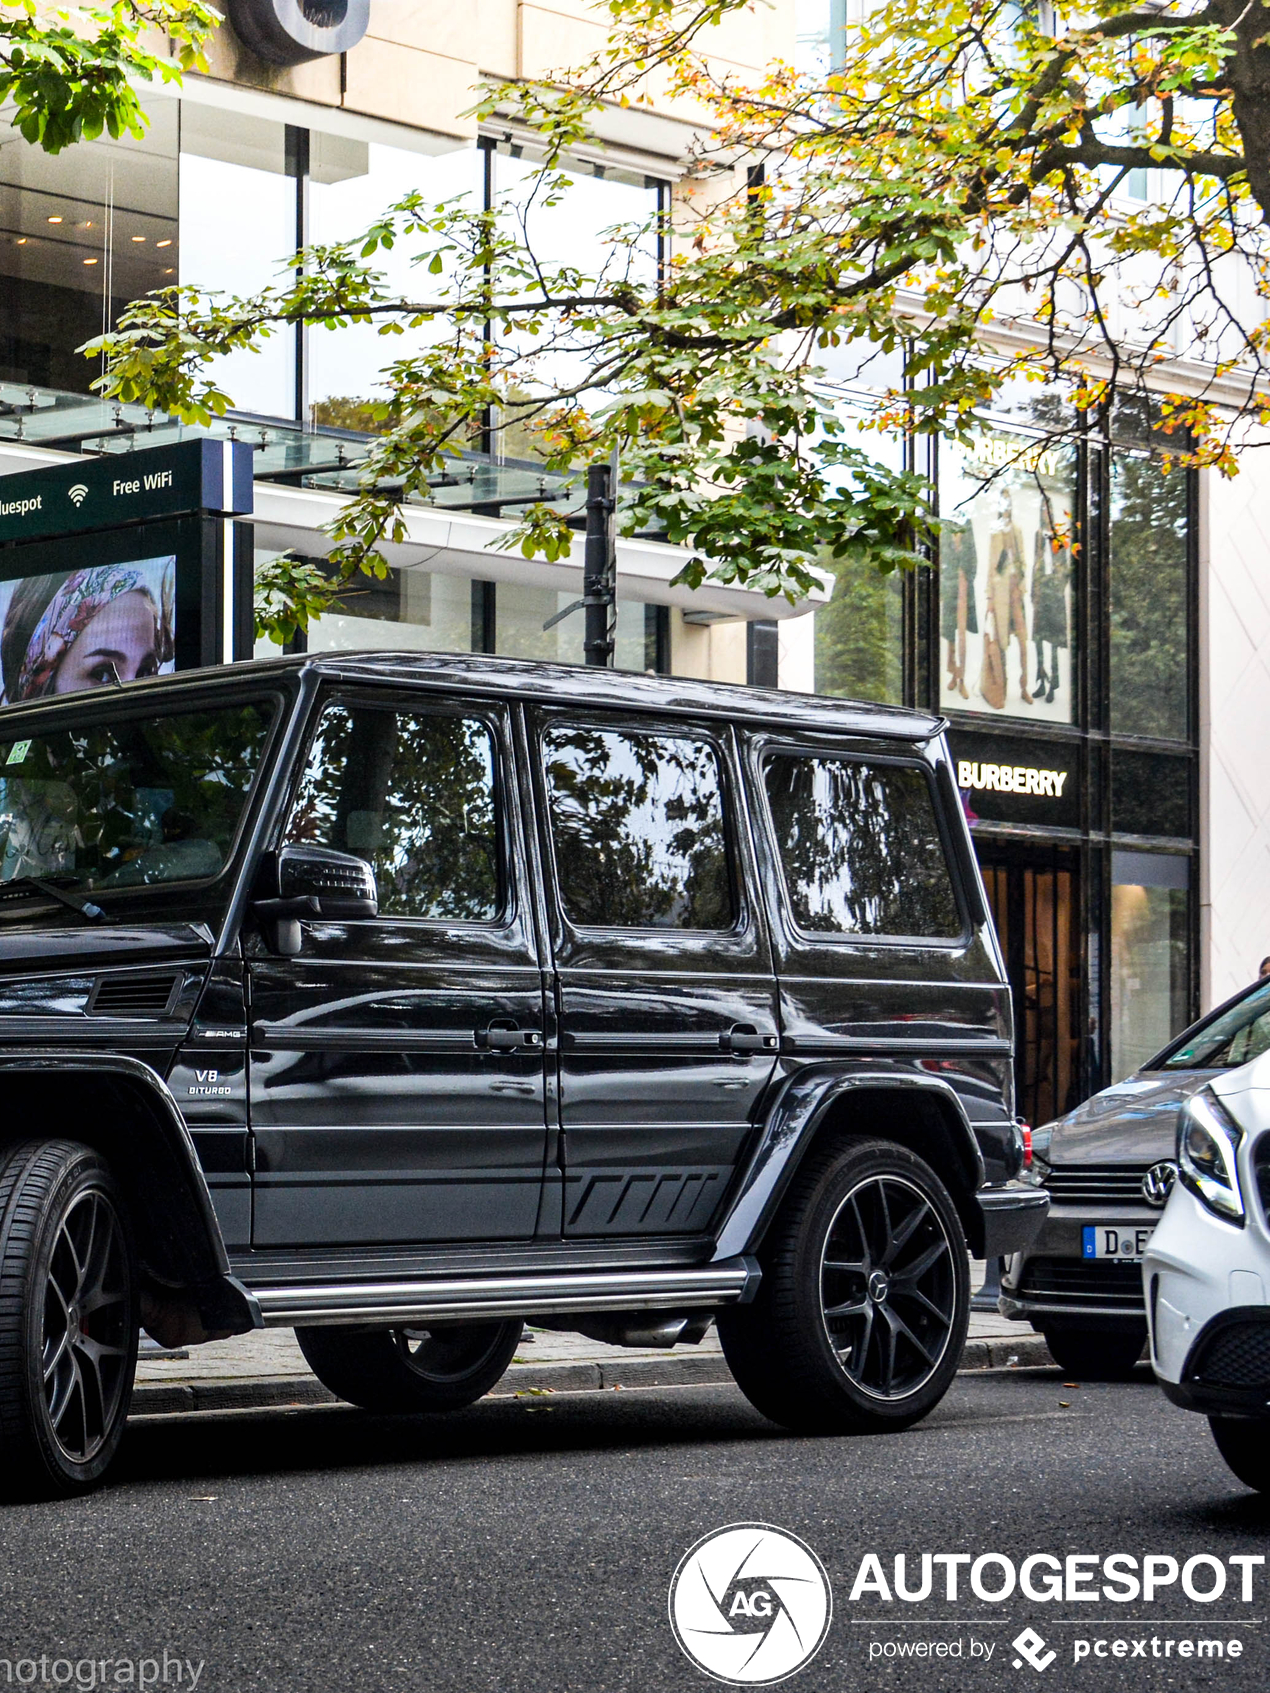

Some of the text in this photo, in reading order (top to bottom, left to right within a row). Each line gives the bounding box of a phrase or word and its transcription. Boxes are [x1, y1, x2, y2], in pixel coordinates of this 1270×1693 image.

[113, 480, 140, 496] Free
[143, 470, 172, 490] WiFi
[958, 760, 1068, 797] BURBERRY
[195, 1069, 218, 1082] V8
[188, 1086, 231, 1095] BITURBO
[1104, 1229, 1155, 1255] D E
